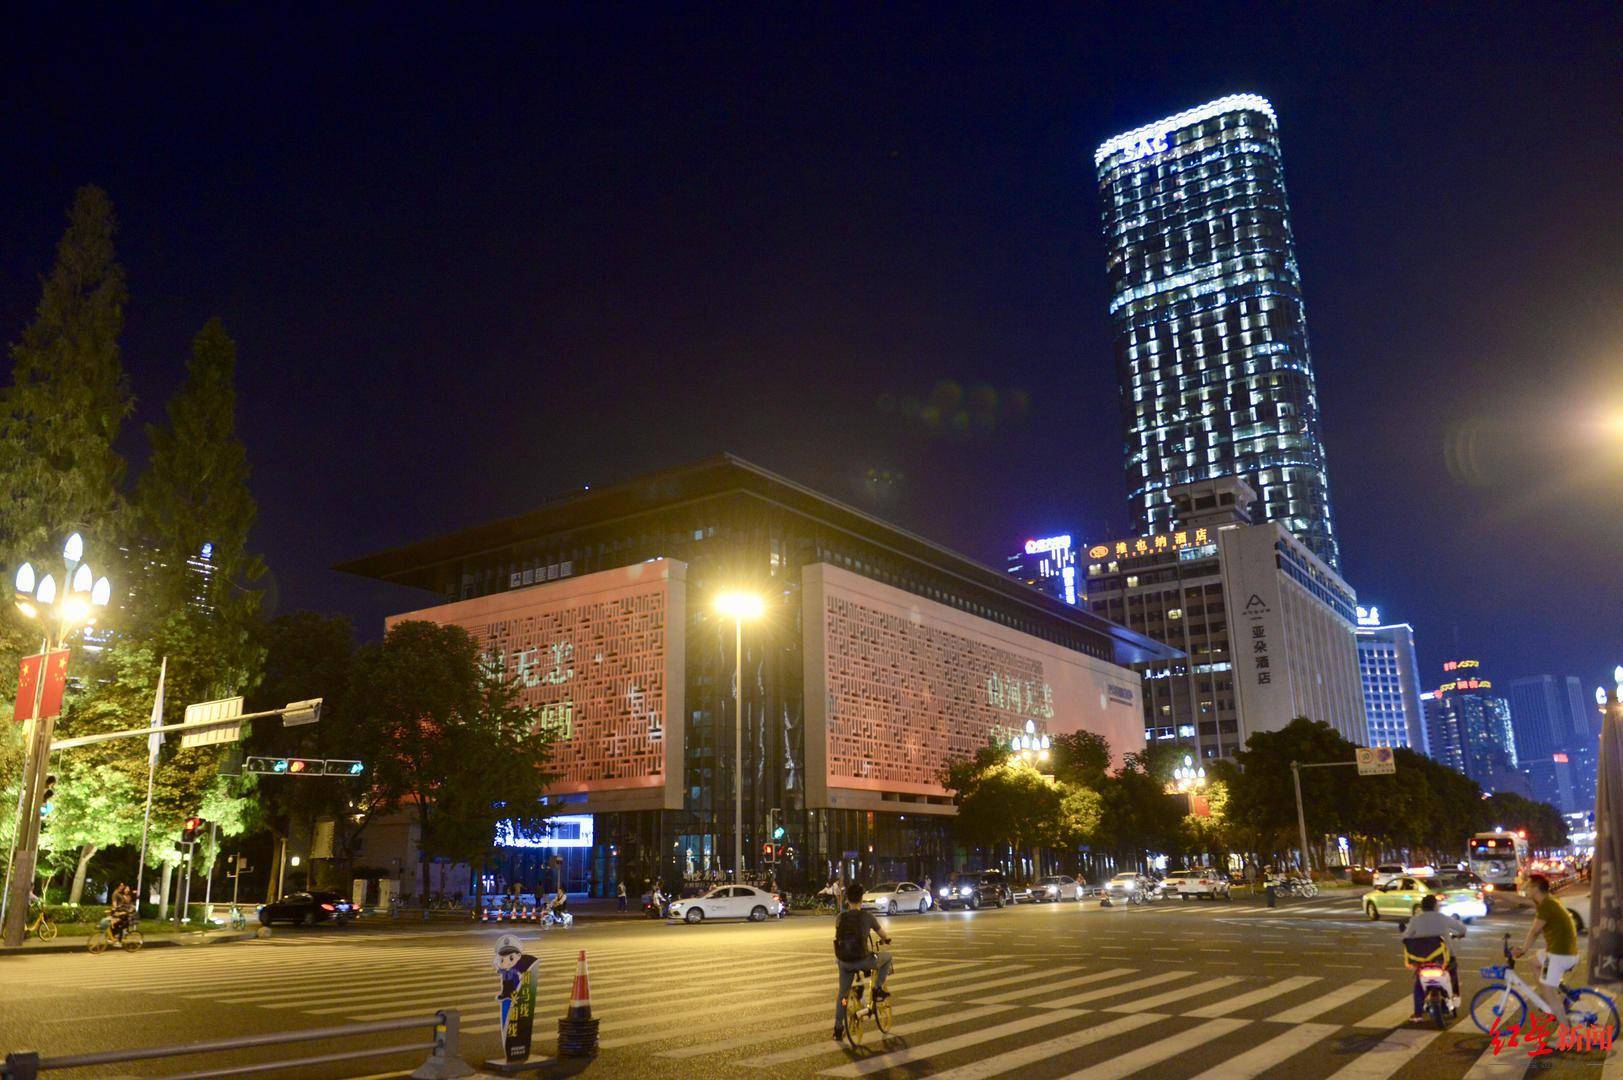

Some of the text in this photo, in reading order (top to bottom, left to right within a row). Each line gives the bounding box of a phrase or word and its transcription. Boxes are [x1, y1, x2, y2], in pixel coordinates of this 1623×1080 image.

[1115, 528, 1208, 554] 维也纳酒店
[1252, 626, 1272, 685] 亚朵酒店
